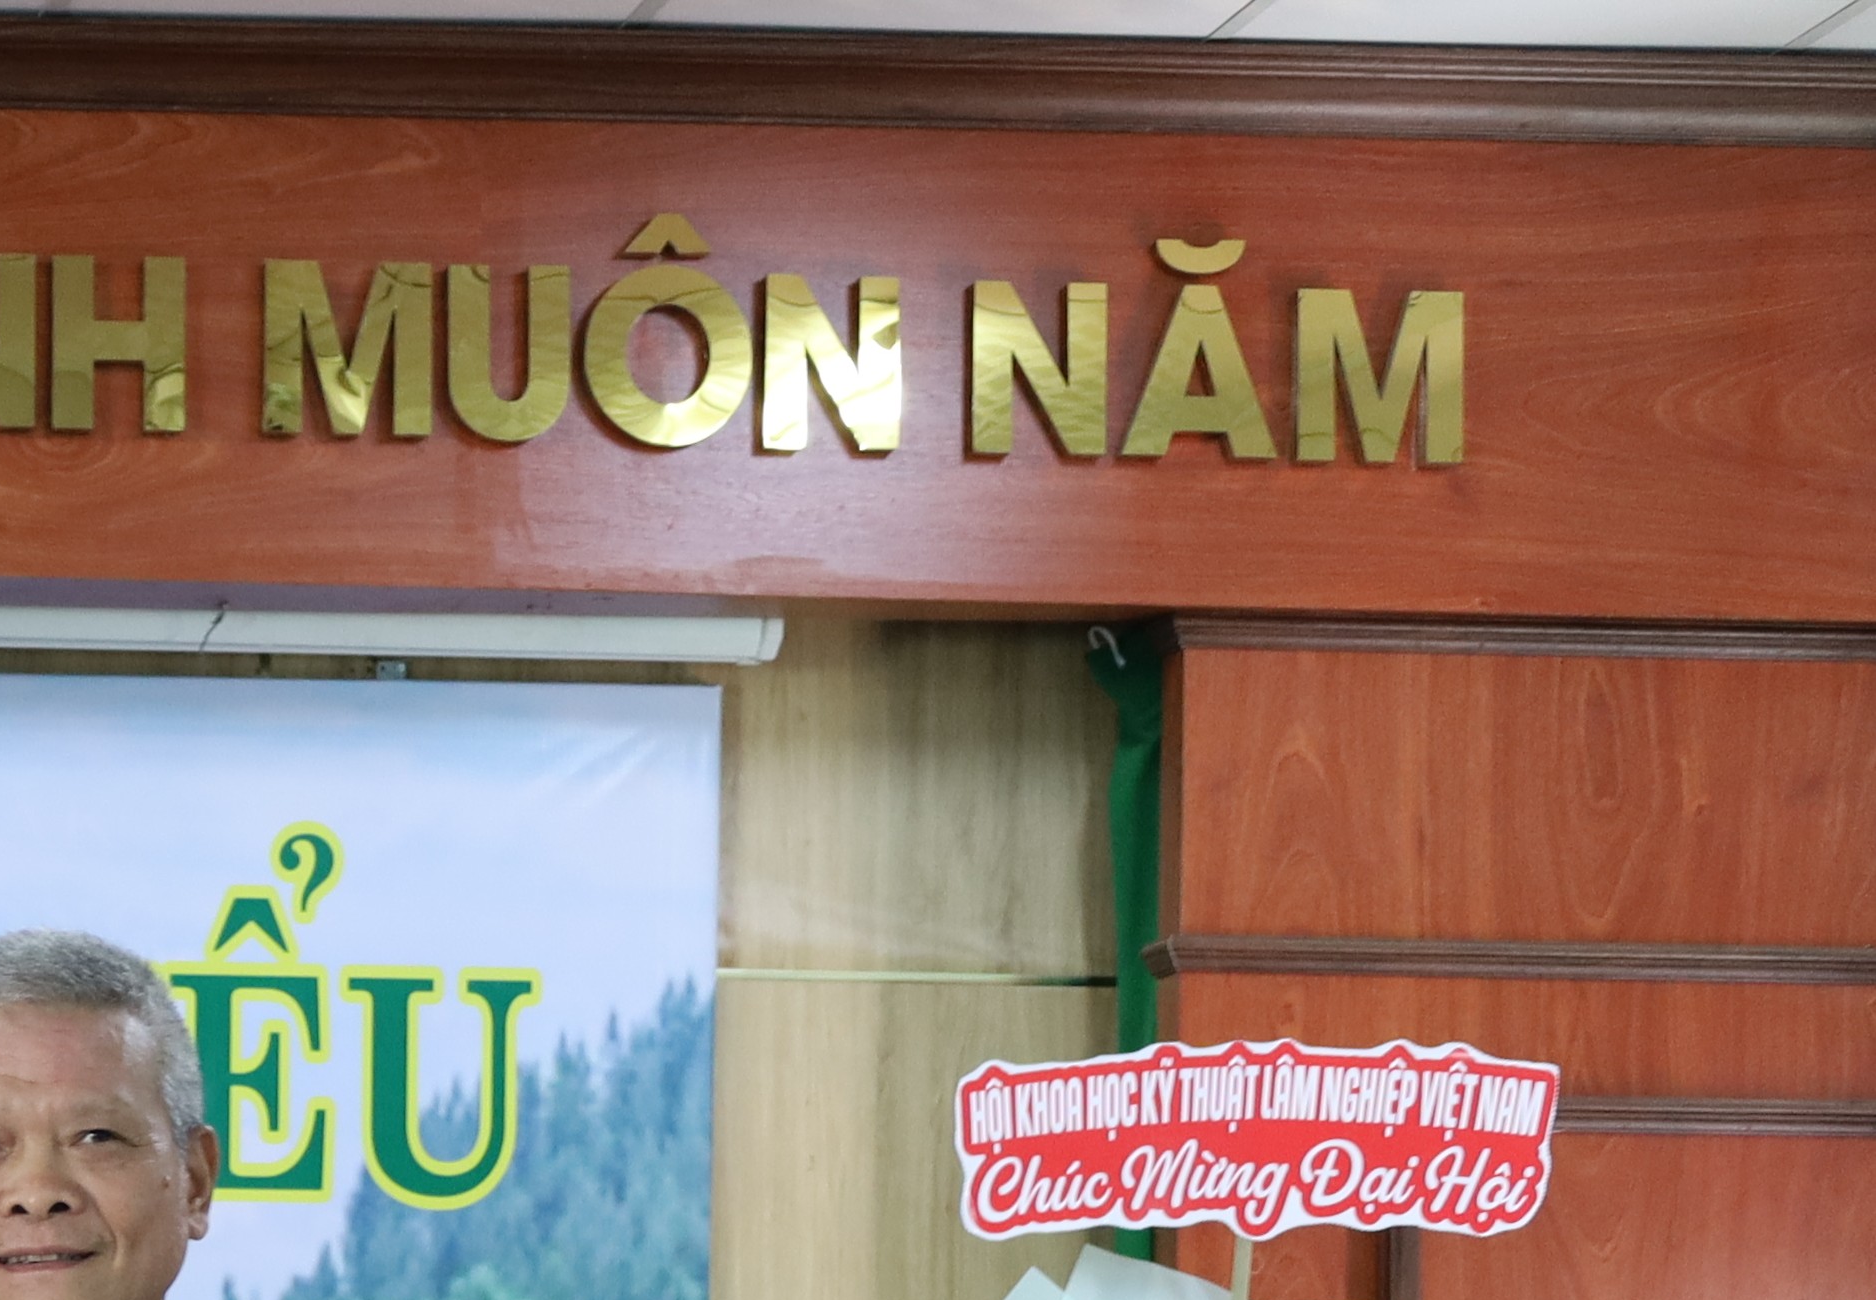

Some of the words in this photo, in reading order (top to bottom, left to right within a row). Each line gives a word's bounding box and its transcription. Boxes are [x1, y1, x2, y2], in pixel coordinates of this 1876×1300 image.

[263, 211, 903, 455] MUÔN
[968, 237, 1467, 470] NĂM
[969, 1077, 1014, 1155] HỘI
[1014, 1077, 1084, 1139] KHOA
[1086, 1071, 1138, 1142] HỌC
[1140, 1056, 1177, 1126] KỸ
[1178, 1055, 1260, 1134] THUẬT
[1260, 1054, 1321, 1121] LÂM
[1319, 1057, 1420, 1138] NGHIỆP
[1419, 1061, 1479, 1142] VIỆT
[1473, 1074, 1548, 1137] NAM
[978, 1154, 1112, 1224] Chúc
[1120, 1139, 1291, 1227] Mừng
[1300, 1137, 1416, 1213] Đại
[1422, 1146, 1537, 1225] Hội
